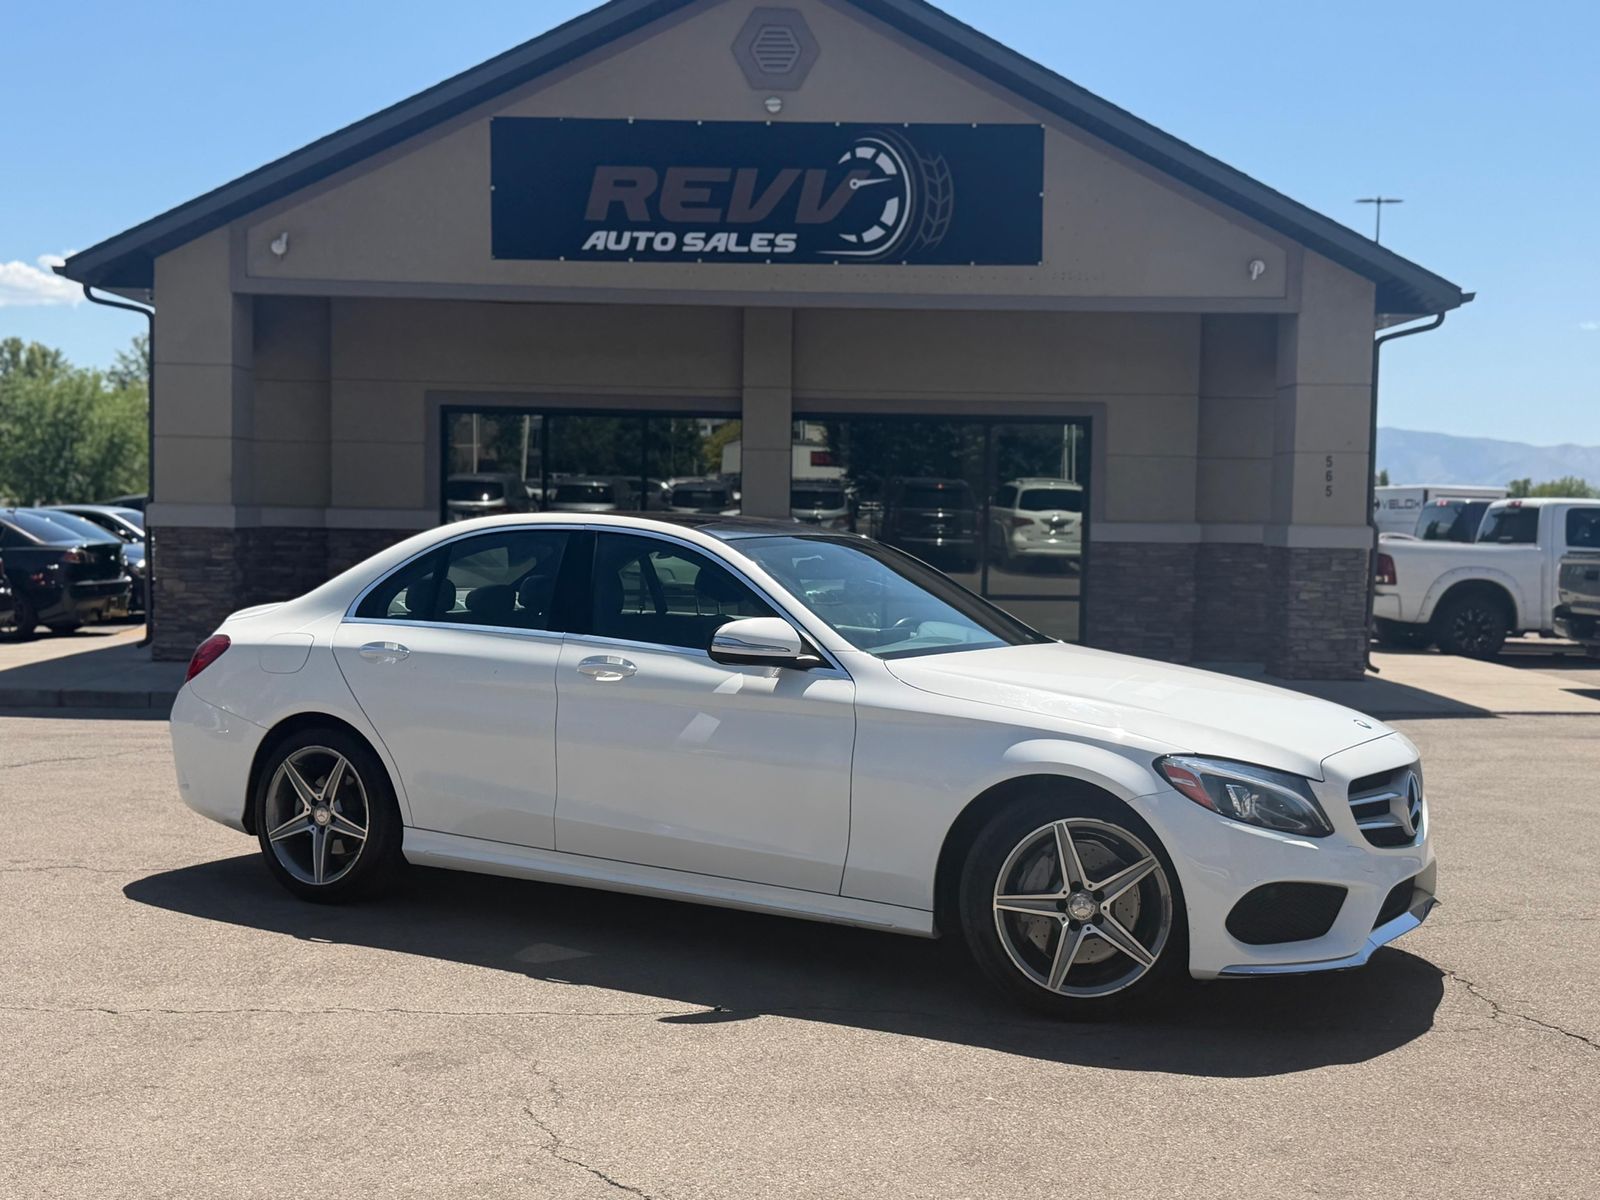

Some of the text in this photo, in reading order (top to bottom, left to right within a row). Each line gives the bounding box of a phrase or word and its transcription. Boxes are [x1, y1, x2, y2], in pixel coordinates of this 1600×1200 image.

[584, 165, 871, 224] REVV
[581, 230, 798, 253] AUTO SALES
[1325, 455, 1333, 497] 565
